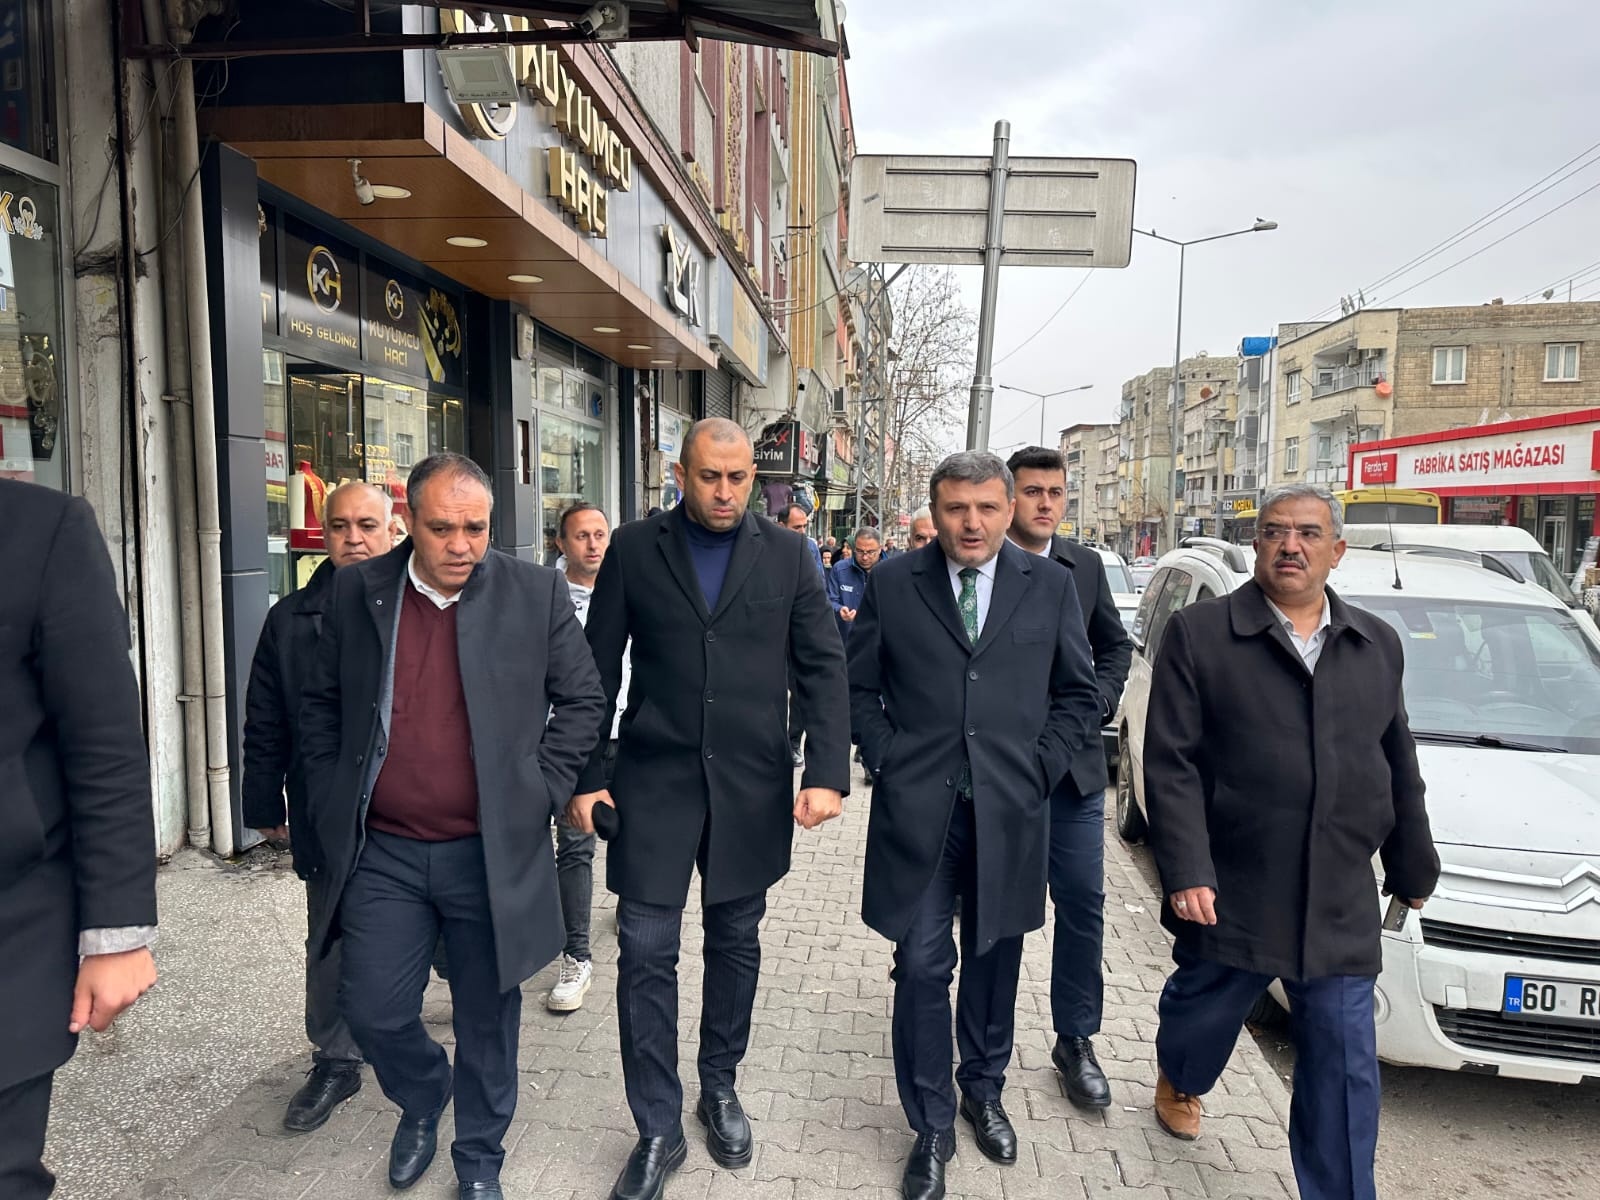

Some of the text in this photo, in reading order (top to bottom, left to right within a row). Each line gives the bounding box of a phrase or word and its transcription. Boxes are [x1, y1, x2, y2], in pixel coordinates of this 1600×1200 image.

[520, 17, 631, 192] KUYUMCU
[291, 318, 358, 349] HOŞ GELDİNİZ
[369, 320, 420, 350] KUYUMCU
[384, 346, 408, 367] HACI
[1414, 442, 1565, 475] FABRİKA SATIŞ MAĞAZASI
[1508, 983, 1600, 1016] TR 60 R
